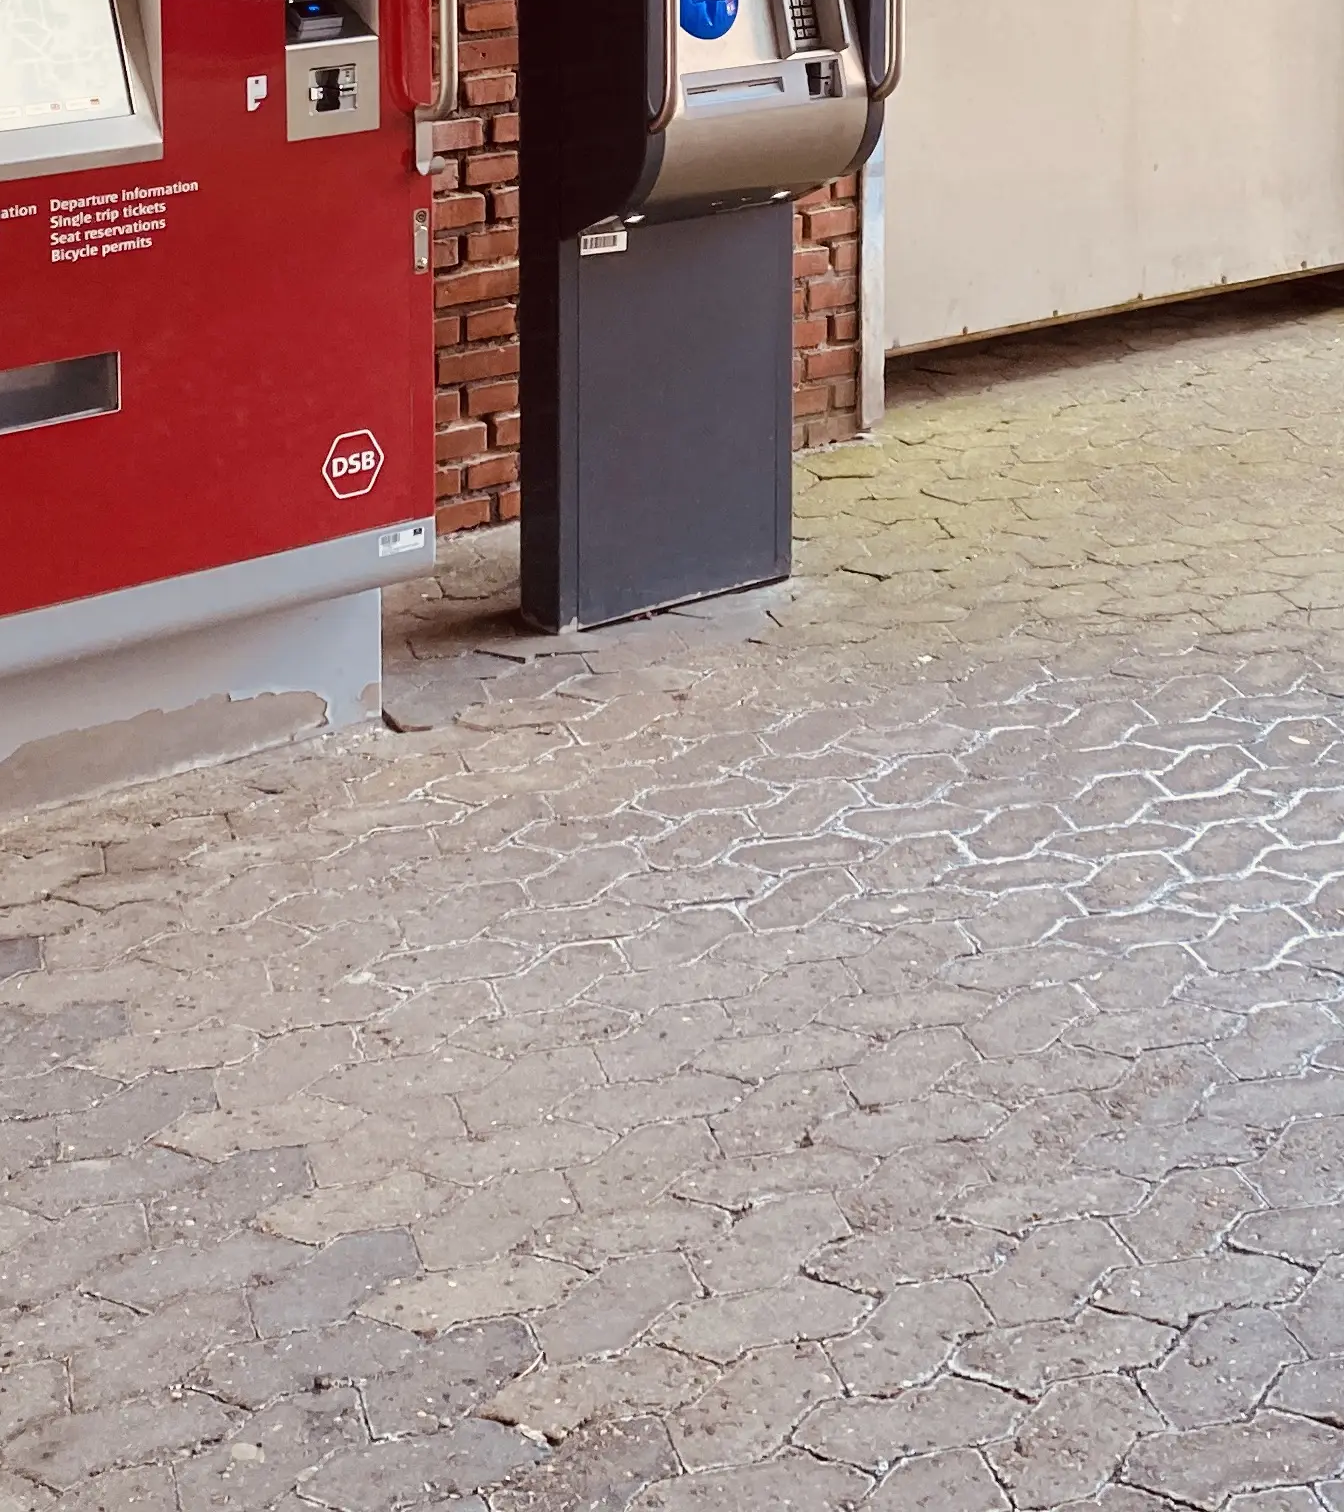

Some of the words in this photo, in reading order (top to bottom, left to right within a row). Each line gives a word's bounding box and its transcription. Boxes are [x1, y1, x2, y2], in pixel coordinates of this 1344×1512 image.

[50, 192, 118, 212] Departure
[121, 181, 199, 201] information
[50, 211, 92, 229] Single
[96, 208, 120, 223] trip
[123, 202, 166, 218] tickets
[50, 231, 81, 246] Seat
[84, 218, 166, 240] reservations
[51, 244, 98, 262] Bicycle
[102, 237, 152, 257] permits
[331, 450, 376, 478] DSB
